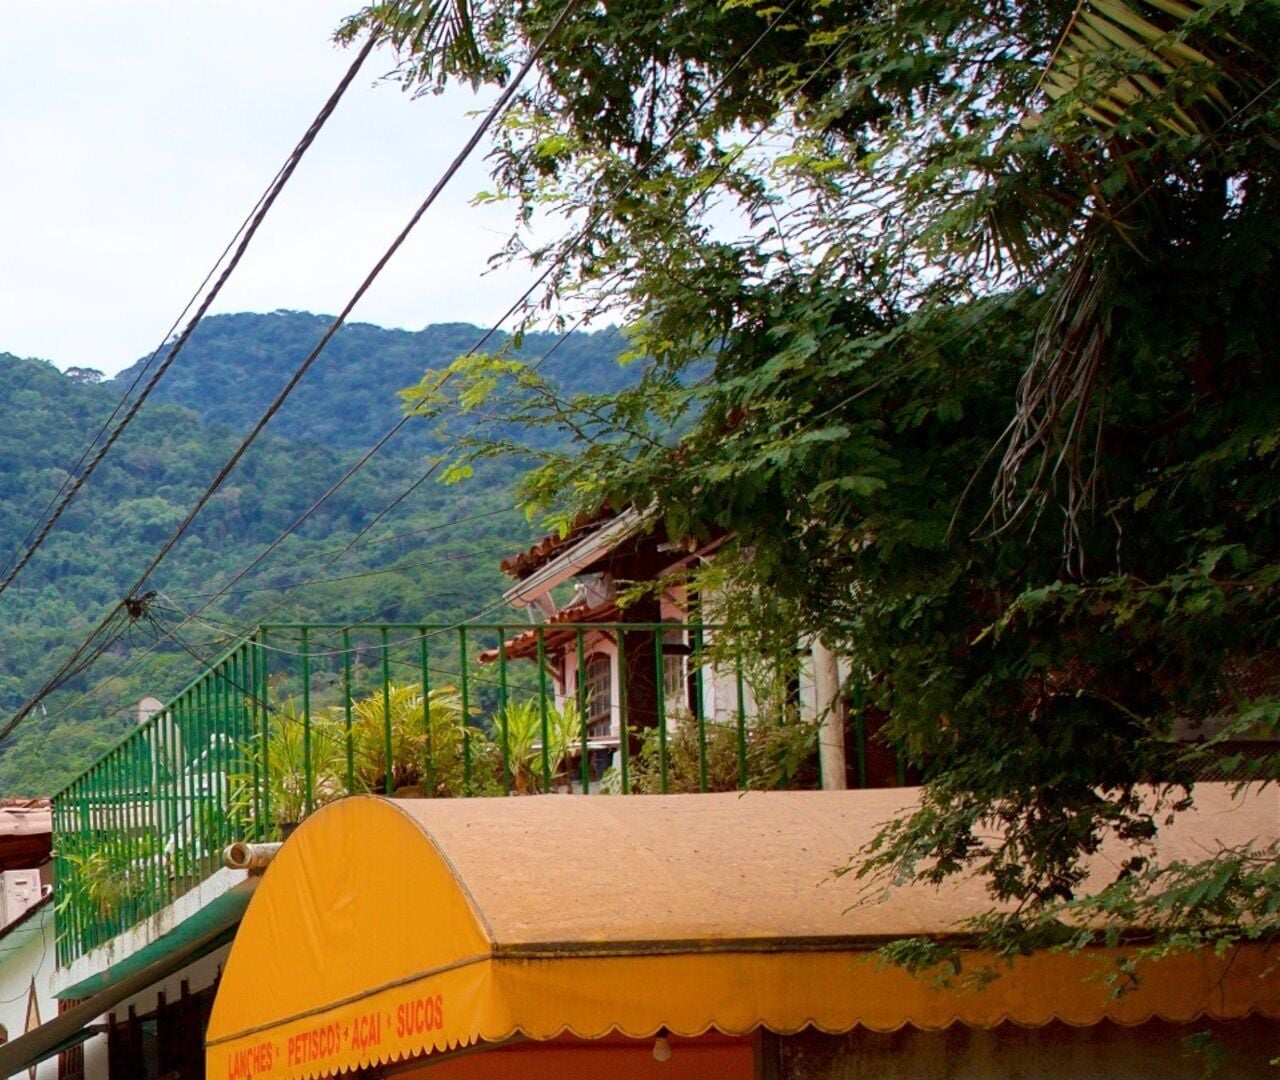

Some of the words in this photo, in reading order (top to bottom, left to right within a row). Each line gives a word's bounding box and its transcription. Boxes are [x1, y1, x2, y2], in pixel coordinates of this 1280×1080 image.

[228, 1041, 273, 1080] LANCHES
[288, 1022, 341, 1067] PETISCOS
[397, 994, 444, 1038] SUCOS
